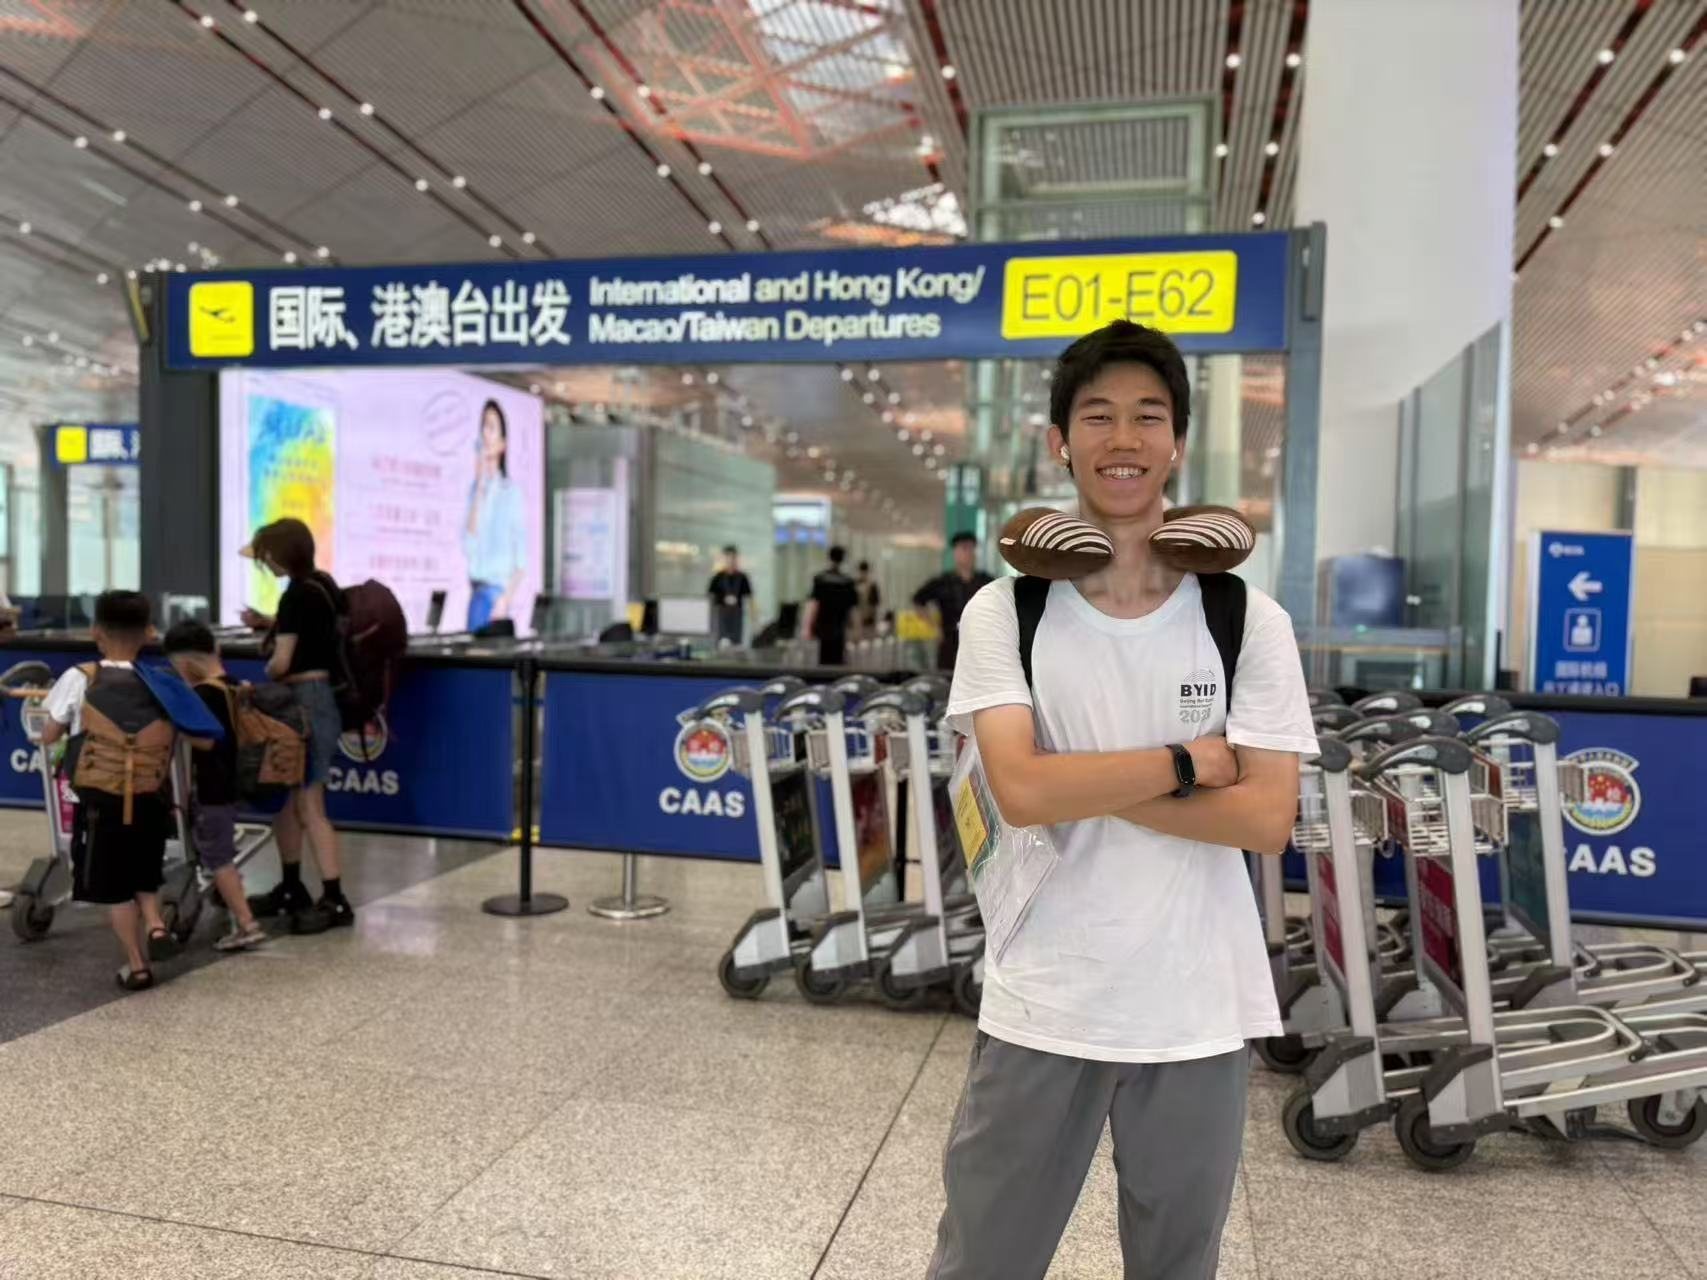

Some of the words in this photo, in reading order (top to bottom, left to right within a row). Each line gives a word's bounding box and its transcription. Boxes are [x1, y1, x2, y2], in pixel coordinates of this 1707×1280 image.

[589, 272, 751, 306] International
[755, 271, 809, 302] and
[814, 269, 891, 306] Hong
[896, 264, 986, 304] Kong/
[1022, 268, 1215, 321] E01-E62
[269, 279, 571, 350] 国际、港澳台出发
[588, 310, 780, 343] Macao/Taiwan
[785, 308, 941, 346] Departures
[326, 766, 400, 796] CAAS
[658, 786, 745, 818] CAAS
[1563, 843, 1657, 877] AAS
